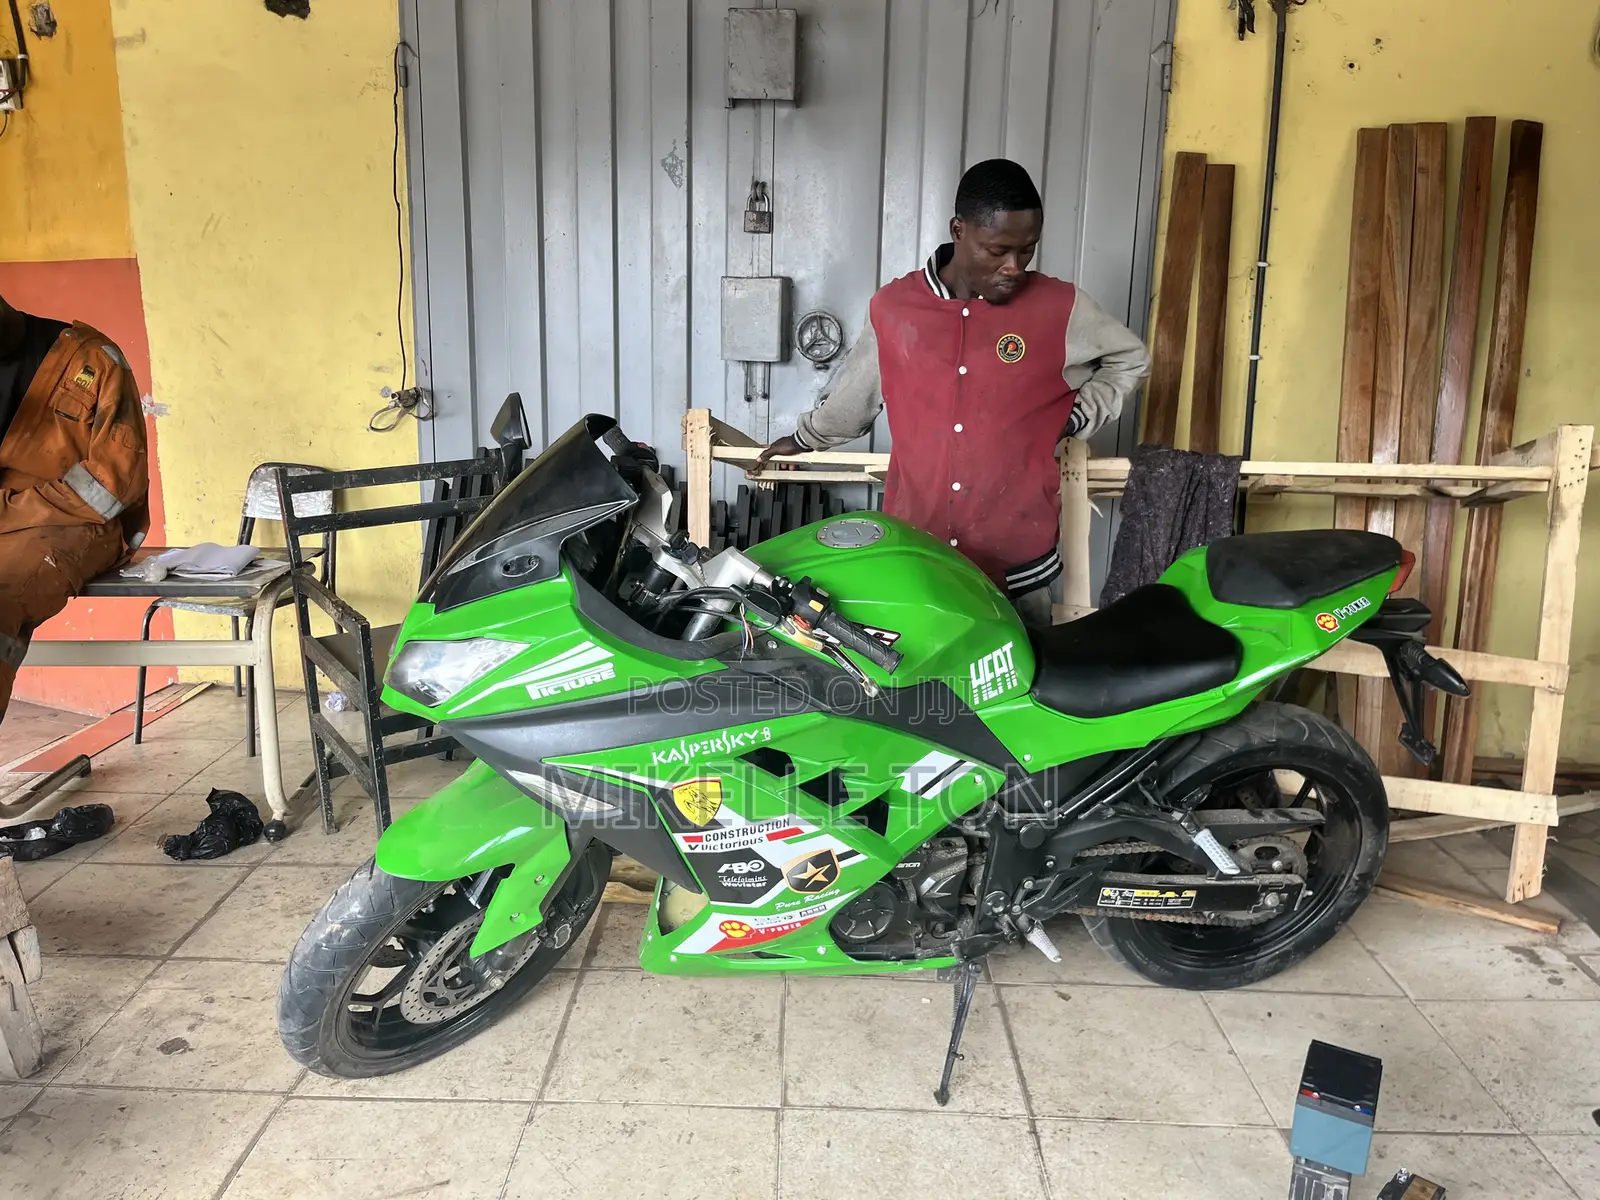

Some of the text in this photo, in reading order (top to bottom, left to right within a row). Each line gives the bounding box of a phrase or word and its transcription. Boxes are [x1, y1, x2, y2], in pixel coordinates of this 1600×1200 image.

[651, 729, 760, 766] KASPERSKY
[704, 818, 790, 843] CONSTRUCTION
[701, 836, 764, 851] Victorious
[774, 902, 801, 912] Pure
[803, 888, 841, 904] Racing
[758, 922, 802, 935] V-POWER
